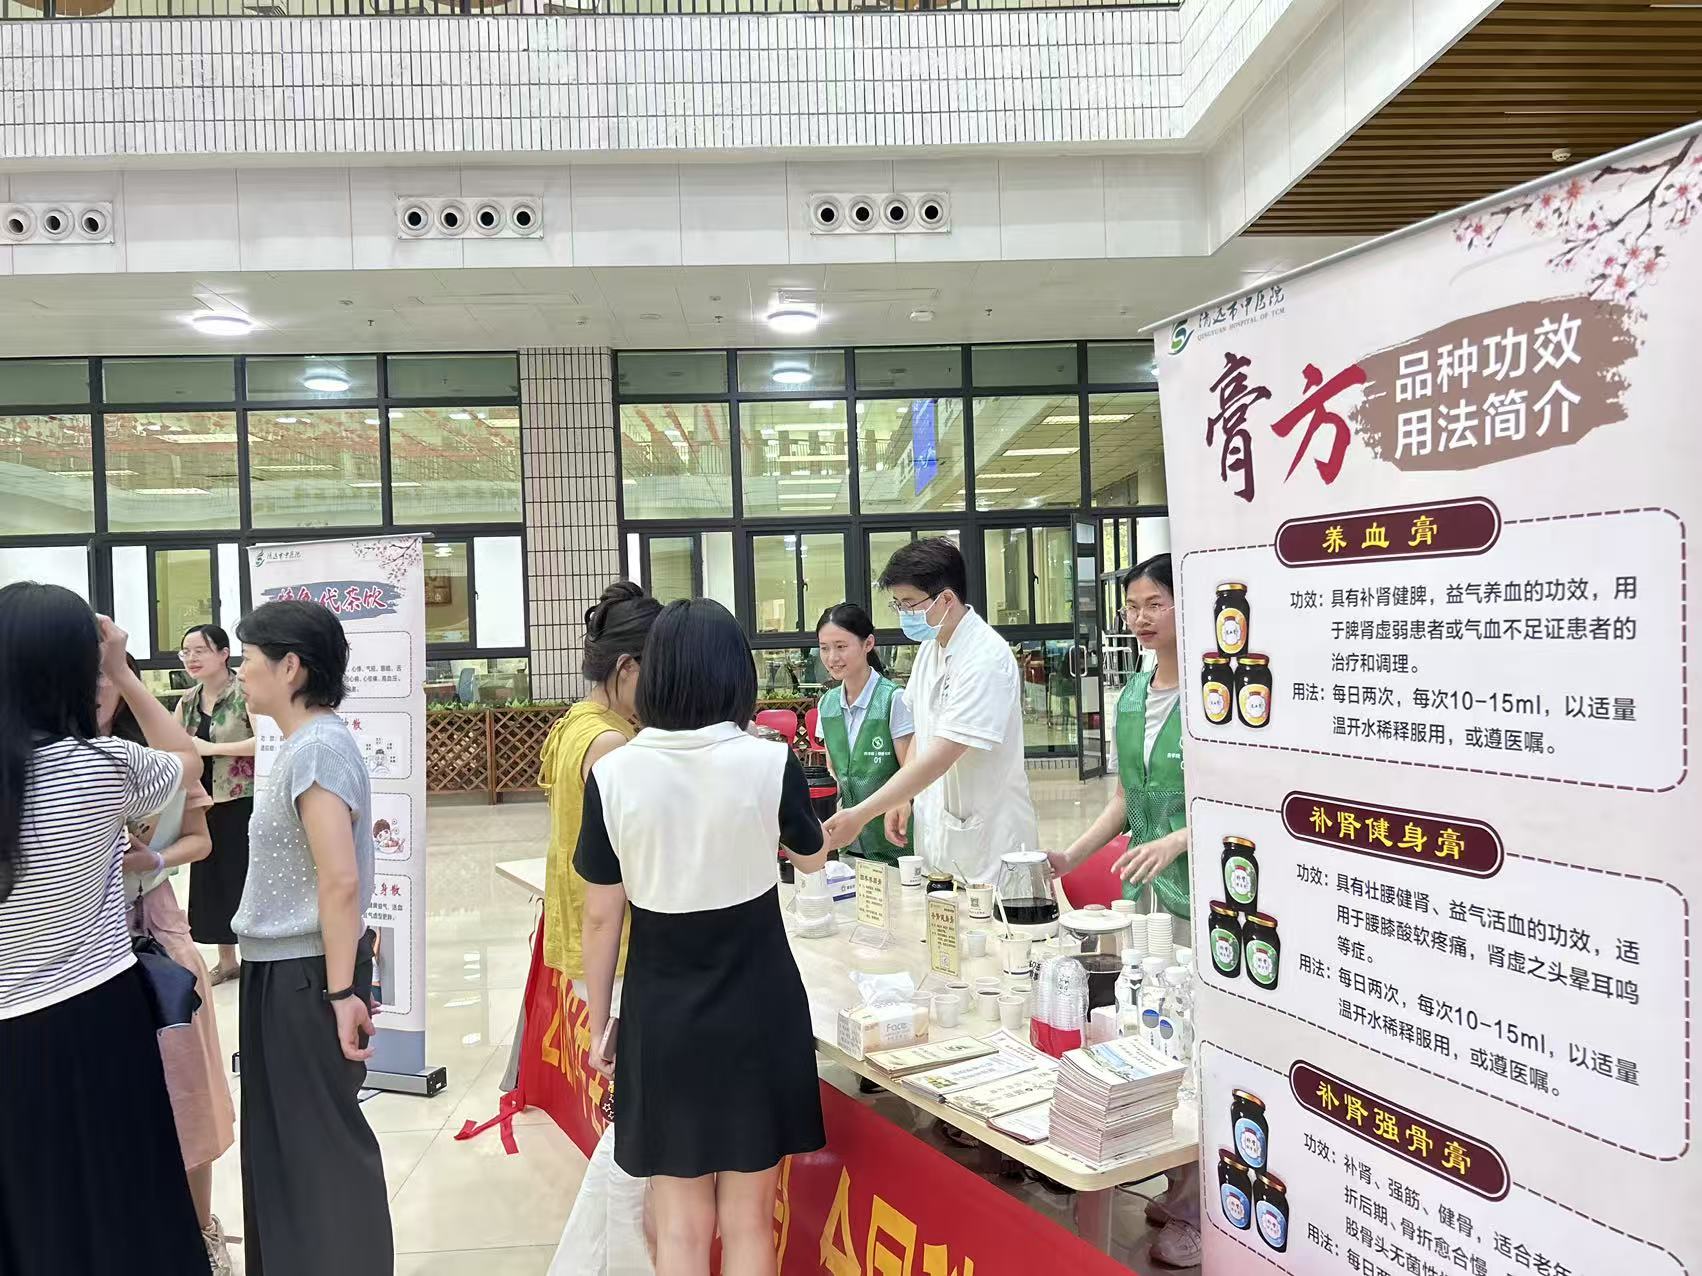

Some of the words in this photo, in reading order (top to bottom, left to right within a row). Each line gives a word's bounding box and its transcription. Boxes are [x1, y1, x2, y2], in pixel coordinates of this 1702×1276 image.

[1271, 307, 1285, 317] TCM
[1395, 313, 1581, 401] 品种功效
[1206, 352, 1367, 502] 膏方
[1395, 381, 1581, 459] 用法简介
[1322, 515, 1438, 553] 养血膏
[1331, 616, 1637, 642] 于脾肾虚弱患者或气血不足证患者的
[1331, 652, 1418, 675] 治疗和调理。
[1332, 717, 1556, 756] 温开水稀释服用，或遵医嘱。
[1309, 806, 1465, 861] 补肾健身膏
[1337, 936, 1375, 965] 等症。
[1337, 905, 1640, 1005] 用于腰膝酸软疼痛，肾虚之头晕耳鸣
[1338, 997, 1560, 1098] 温开水稀释服用，或遵医嘱。
[1316, 1080, 1472, 1176] 补肾强骨膏
